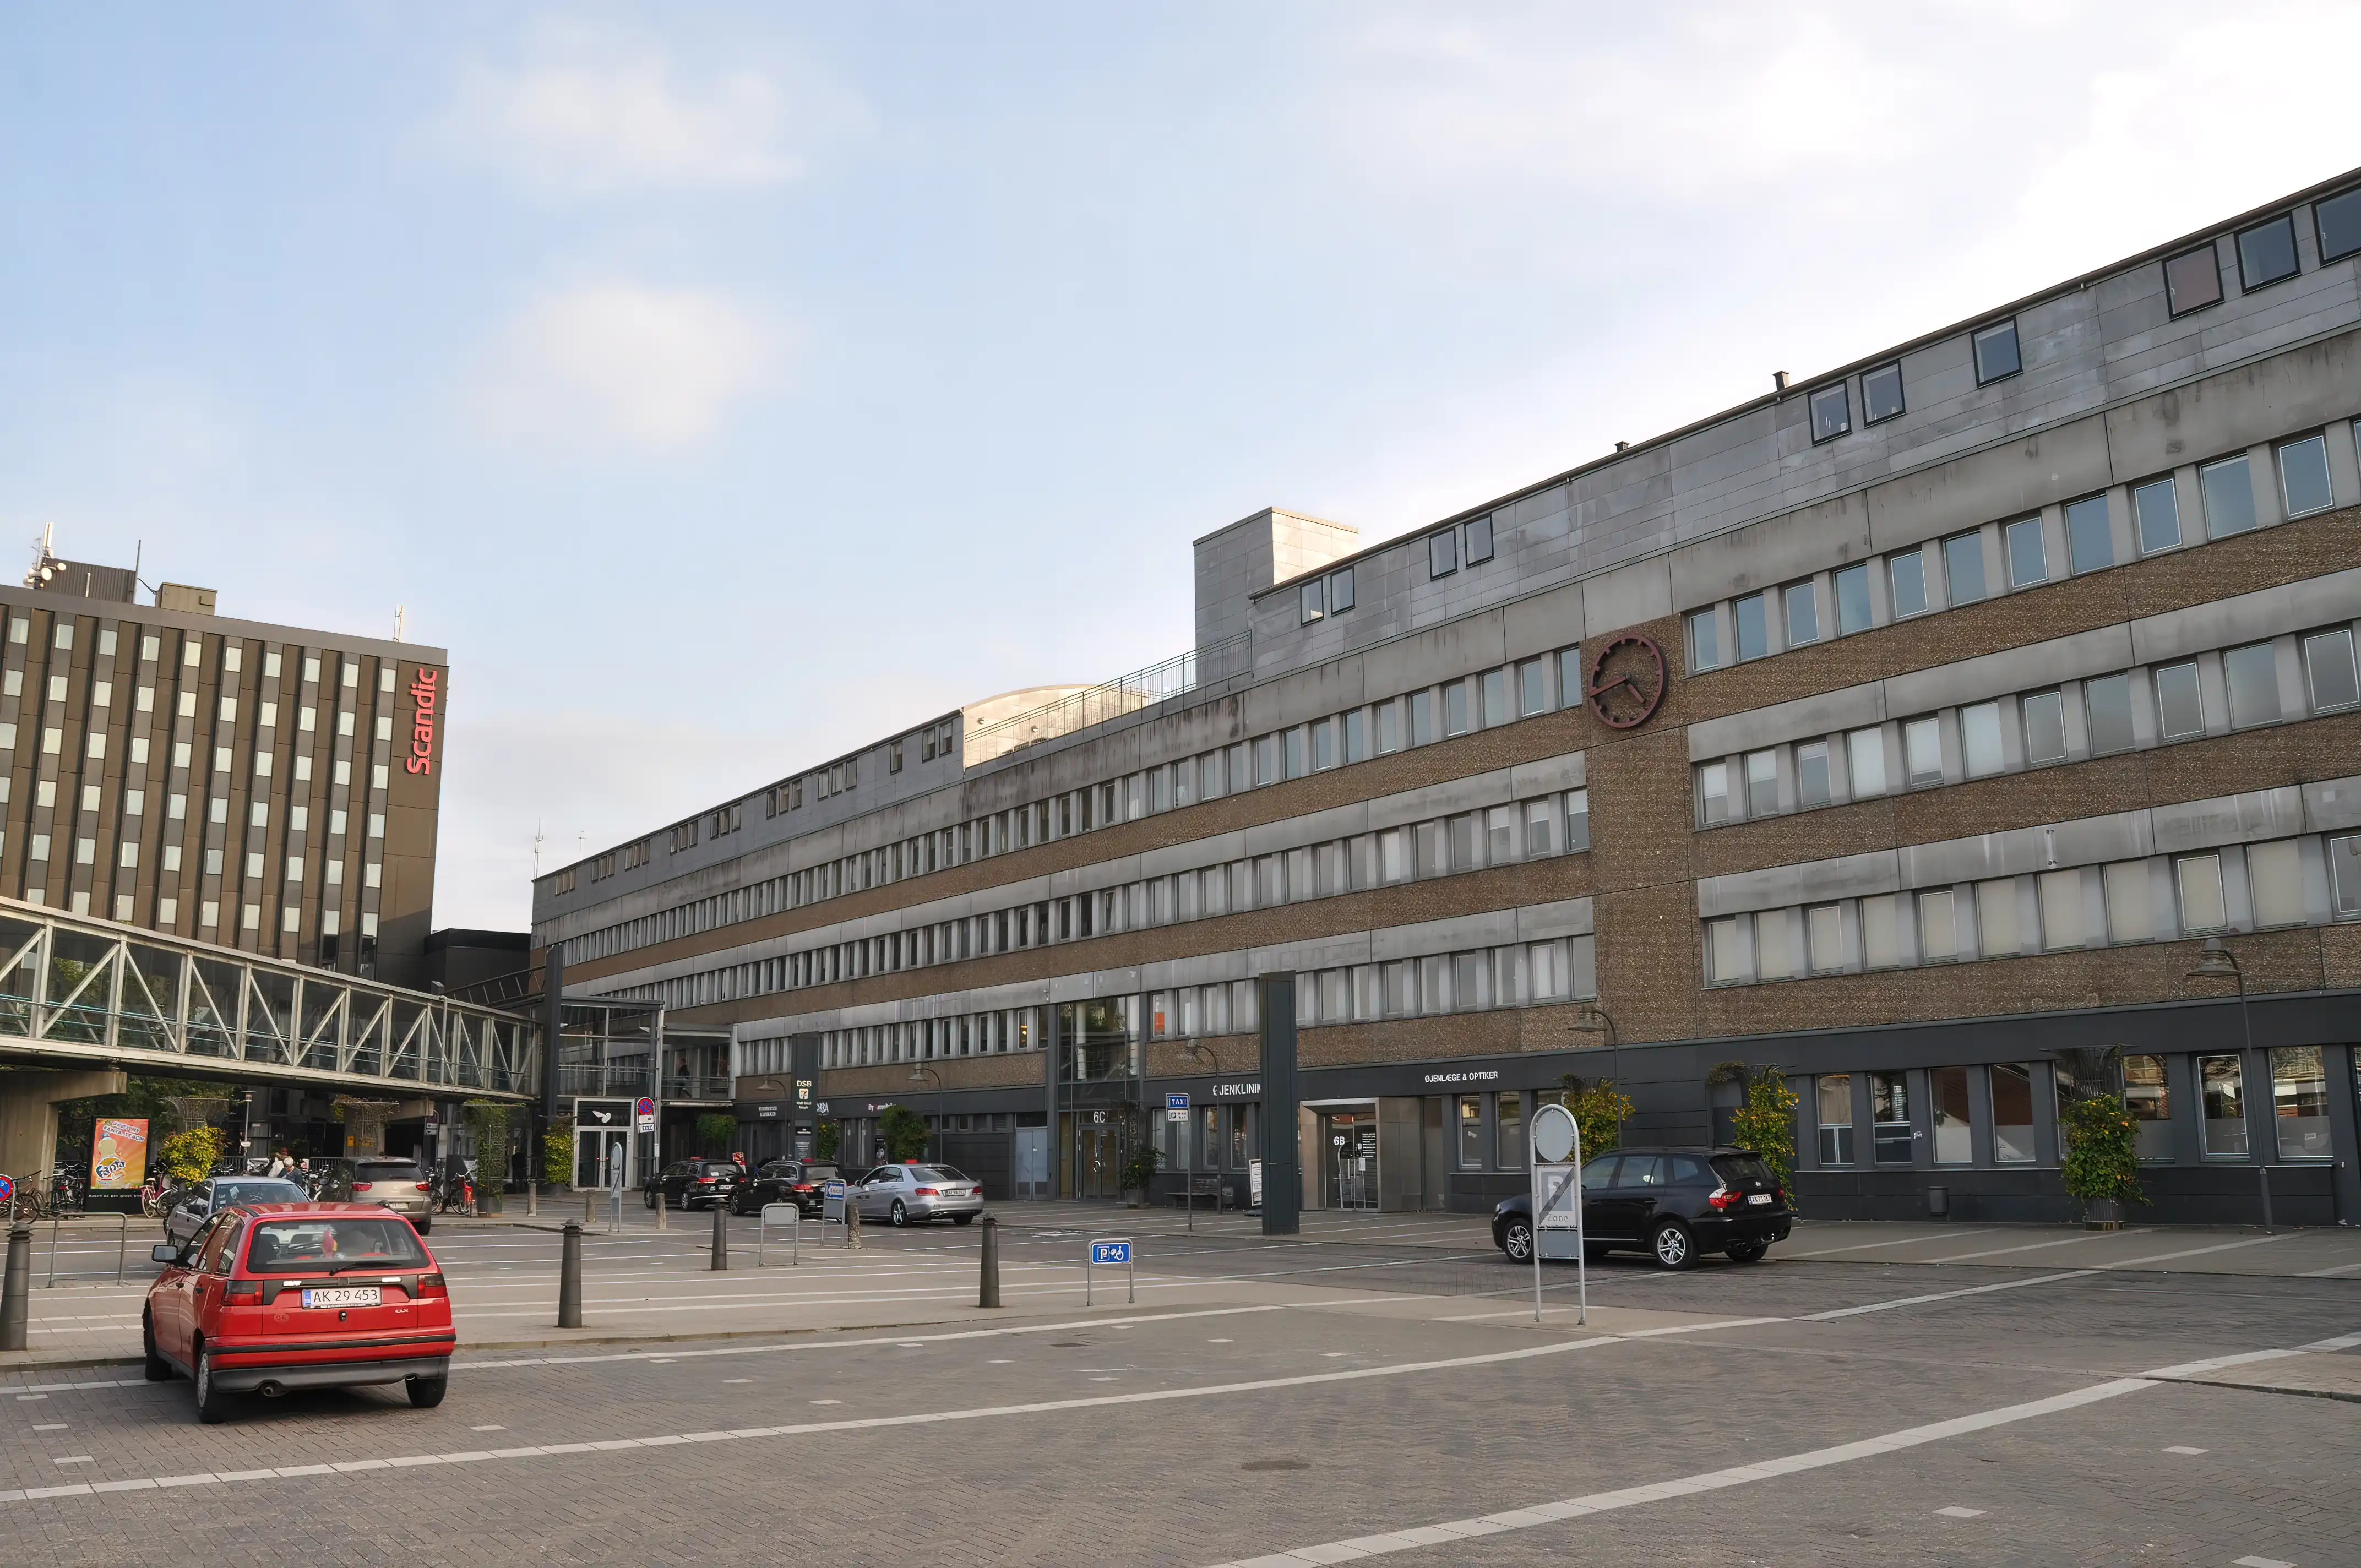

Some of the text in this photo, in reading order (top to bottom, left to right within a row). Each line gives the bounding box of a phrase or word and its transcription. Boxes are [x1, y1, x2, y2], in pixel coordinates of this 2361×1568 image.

[406, 668, 437, 775] Scandic
[1424, 1074, 1461, 1082] ØJENLÆGE
[1469, 1071, 1498, 1080] OPTIKER
[1094, 1111, 1105, 1123] 6C
[1334, 1136, 1345, 1145] 6B
[96, 1160, 126, 1178] Fanta
[1547, 1213, 1568, 1222] Zone
[313, 1289, 377, 1303] AK 29 453
